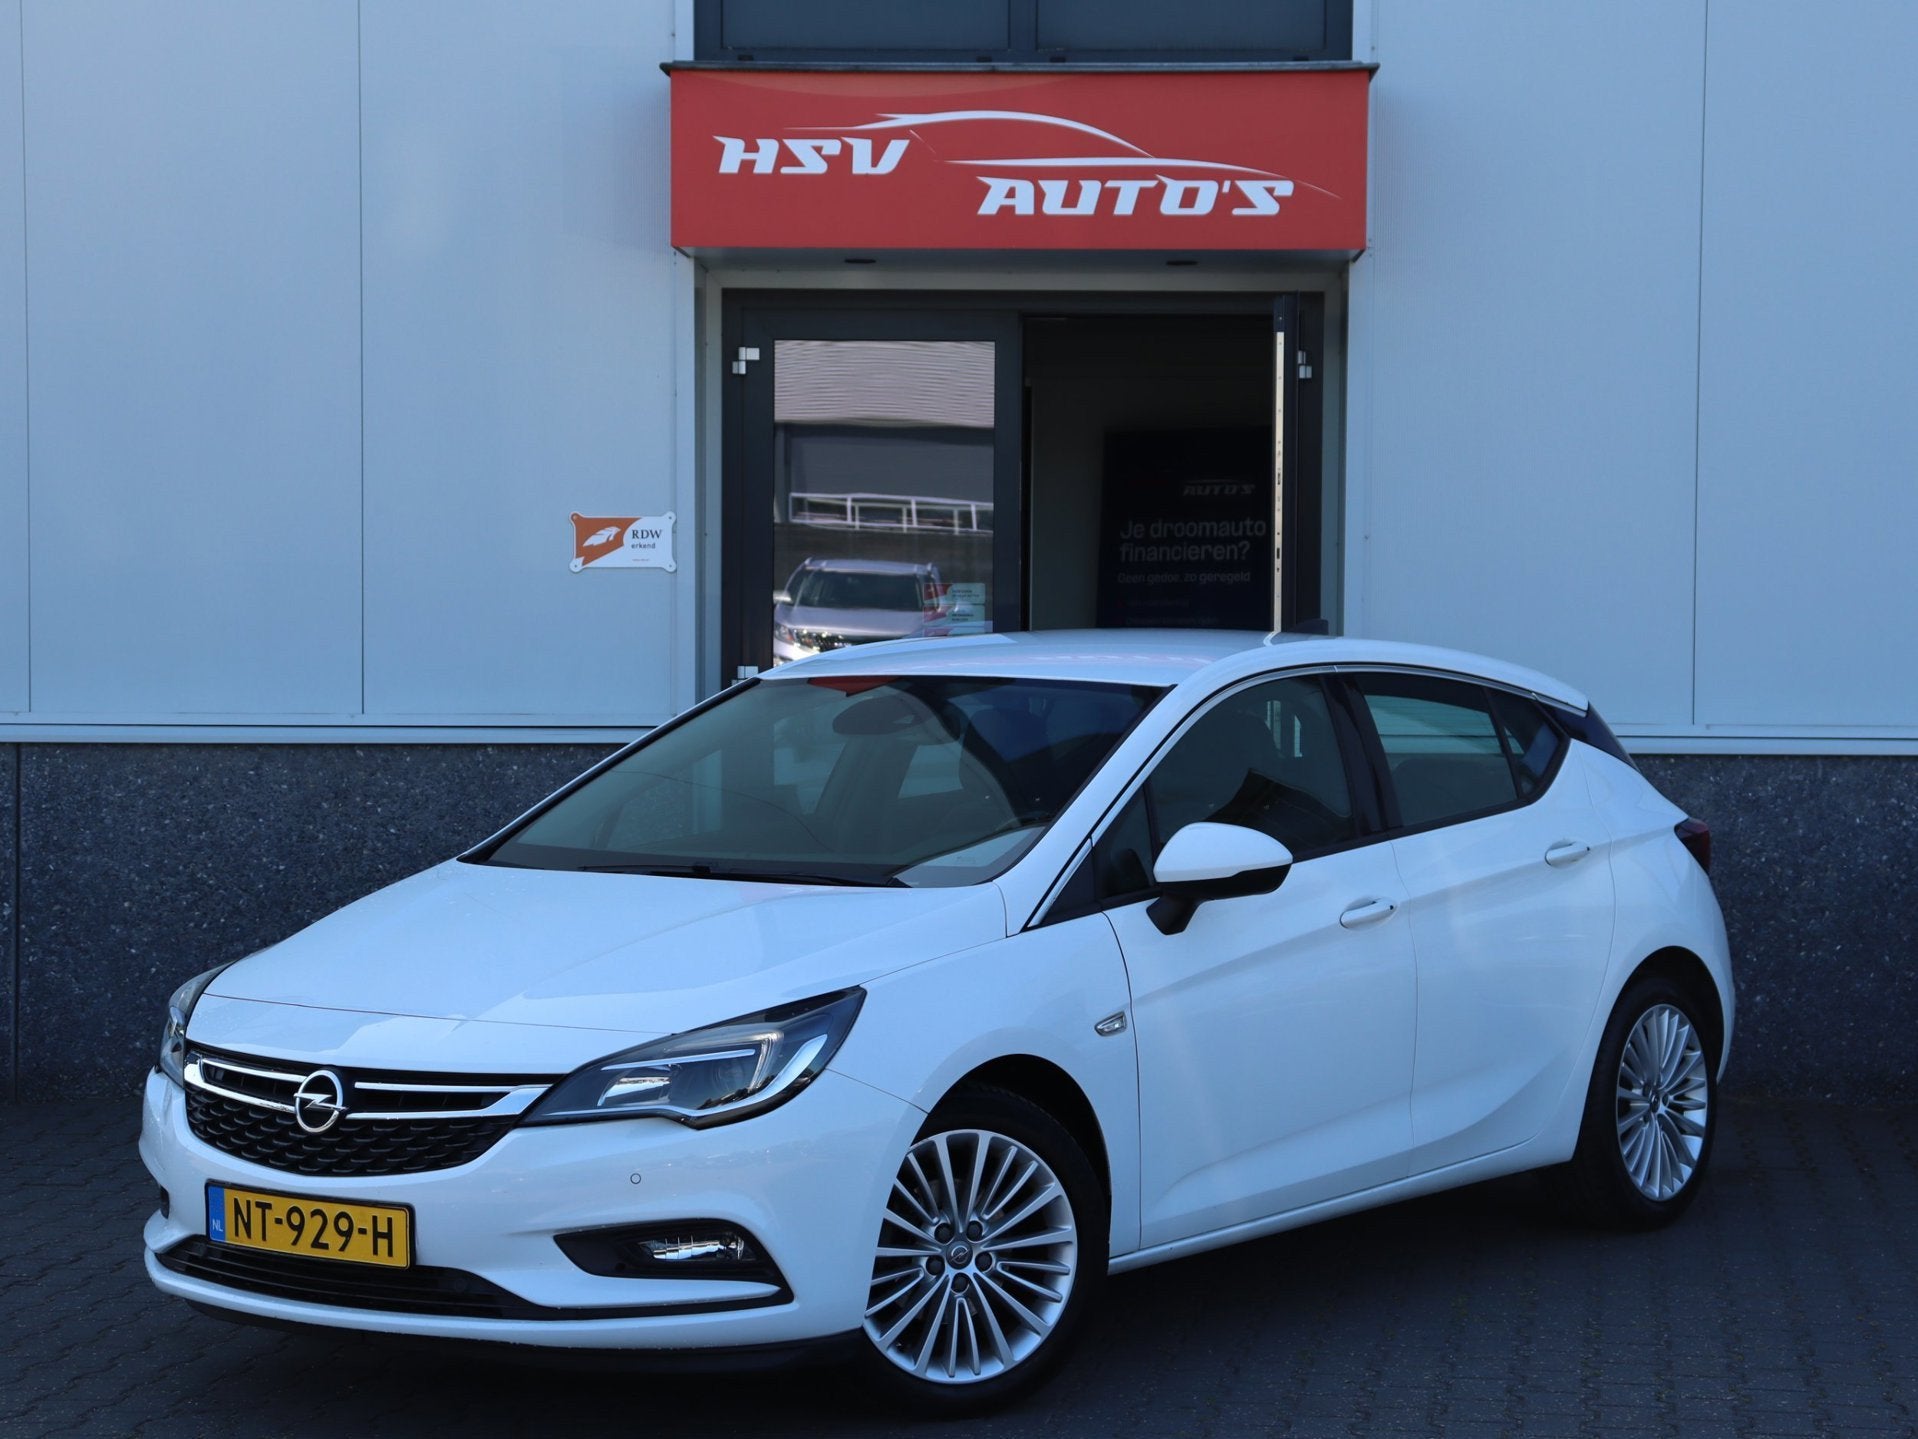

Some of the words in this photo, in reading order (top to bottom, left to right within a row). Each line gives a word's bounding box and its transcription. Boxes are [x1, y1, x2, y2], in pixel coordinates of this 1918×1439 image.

[713, 135, 909, 176] HSV
[976, 174, 1294, 216] AUTO'S
[631, 529, 662, 539] RDW
[1120, 520, 1145, 539] Je
[1150, 518, 1267, 538] droomauto
[1120, 540, 1251, 563] financieren?
[1117, 572, 1145, 584] Geen
[1184, 572, 1198, 583] zo
[1198, 571, 1251, 586] geregeld
[212, 1219, 224, 1232] NL
[233, 1198, 394, 1257] NT-929-H
